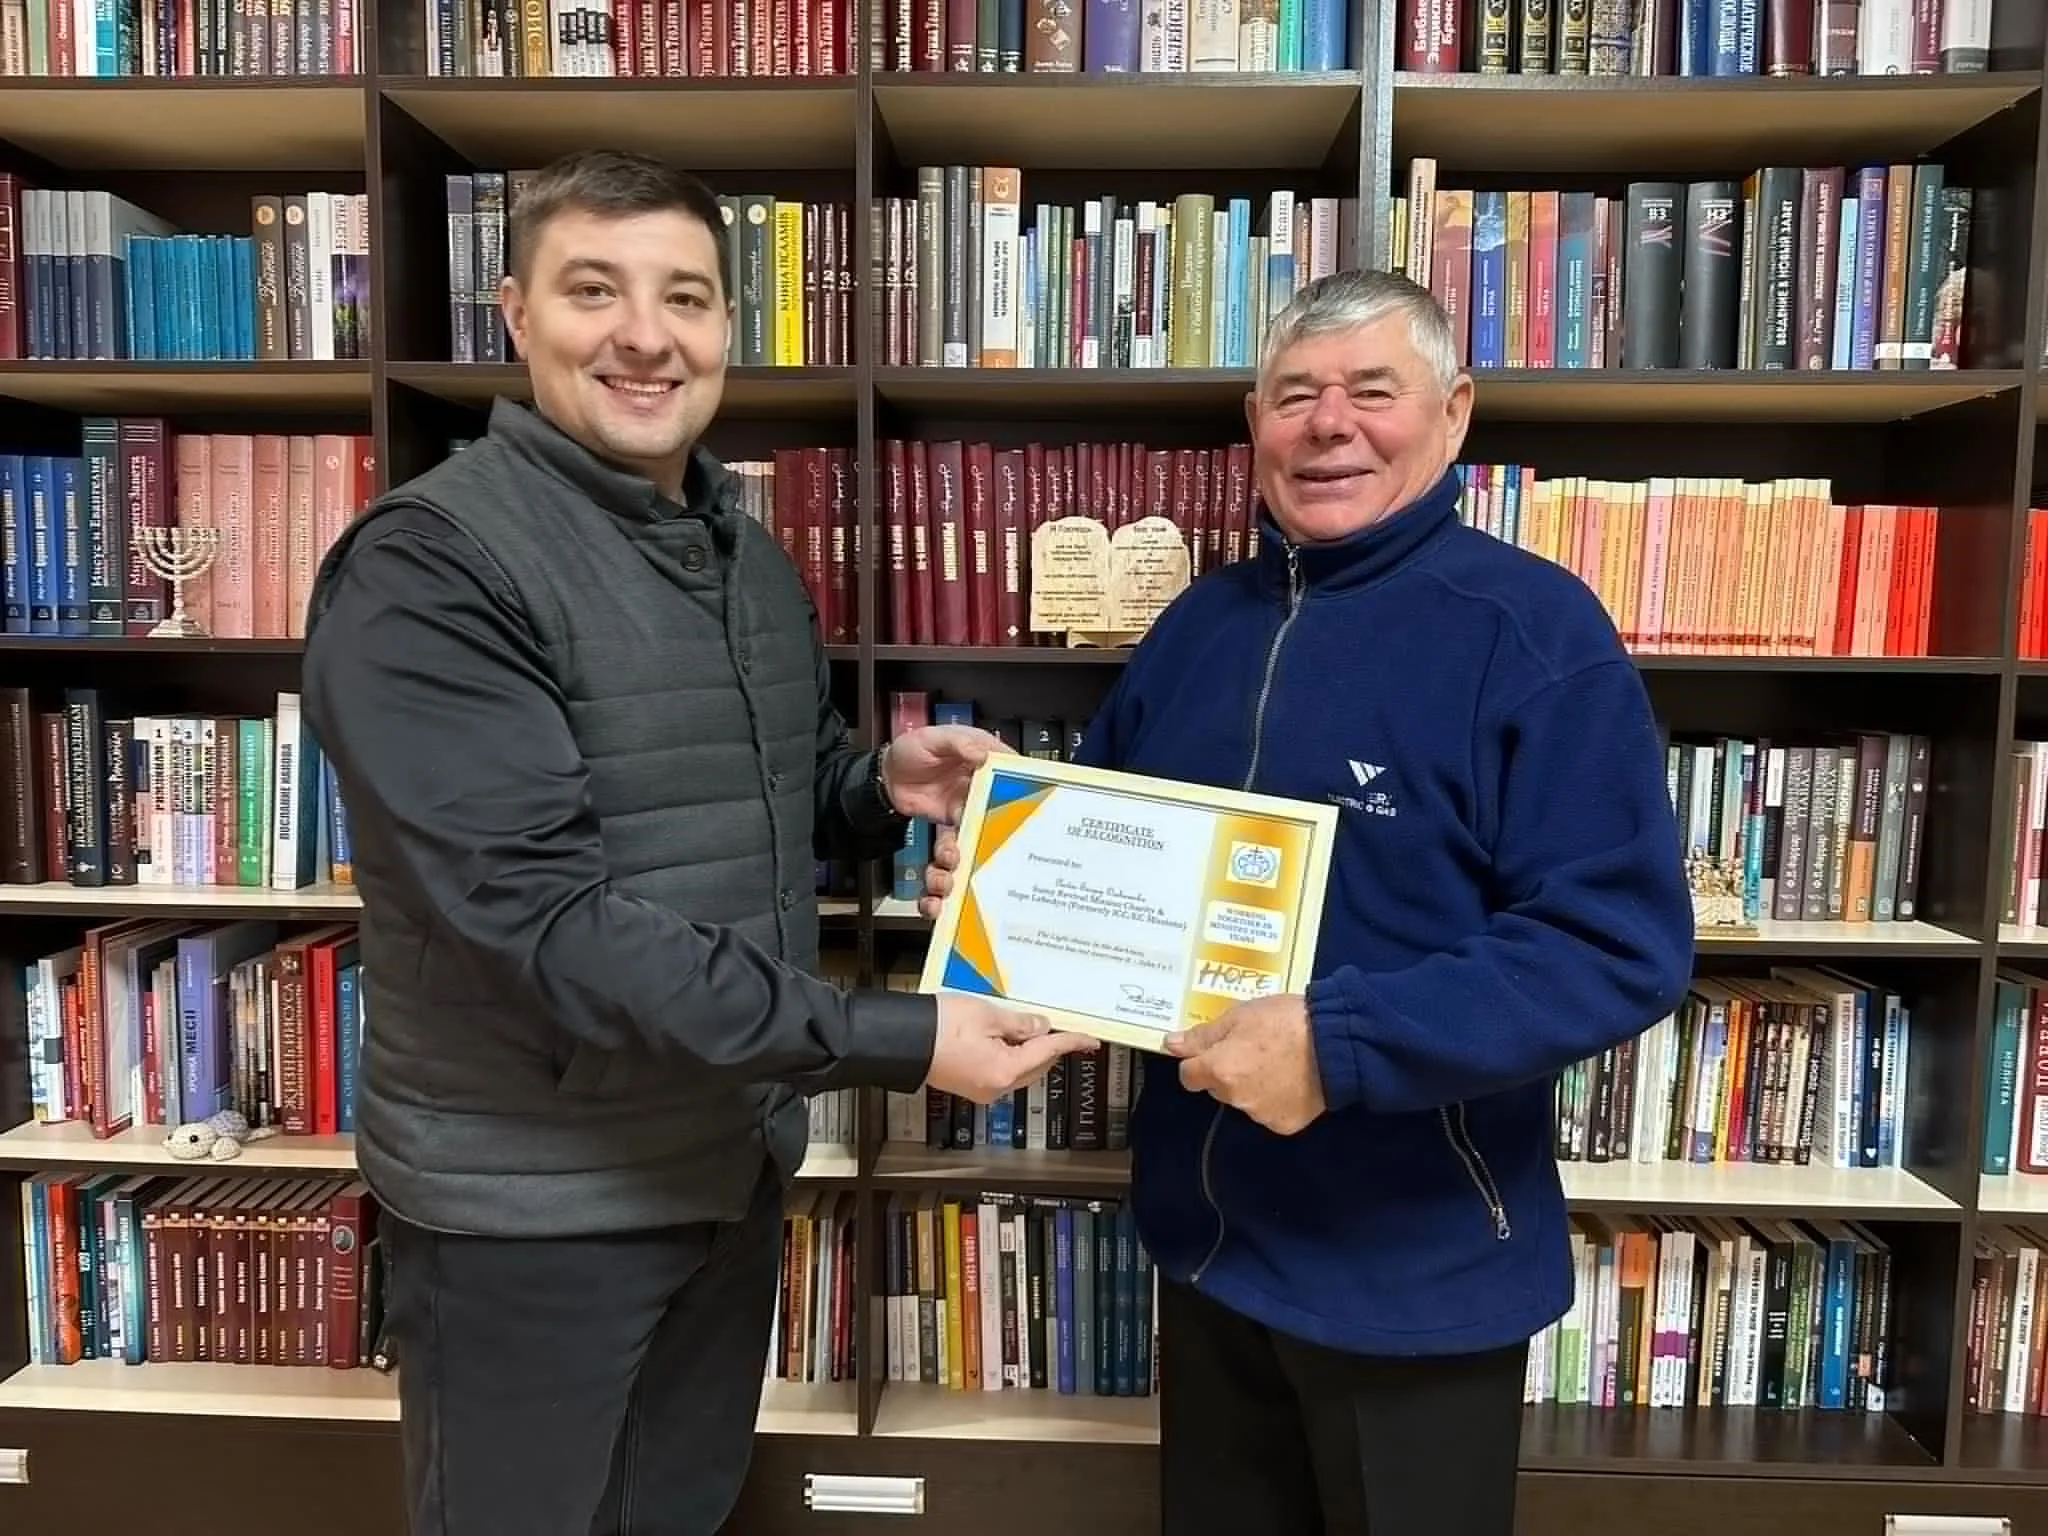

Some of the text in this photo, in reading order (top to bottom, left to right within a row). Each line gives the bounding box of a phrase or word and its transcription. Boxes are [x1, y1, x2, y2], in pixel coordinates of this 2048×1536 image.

[1781, 200, 1793, 234] ЗАВЕТ
[1778, 236, 1791, 278] НОВЫЙ
[155, 729, 163, 738] 1
[1040, 730, 1049, 742] 2
[1082, 817, 1155, 838] CERTIFICATE
[1085, 828, 1164, 850] RECOGNITION
[1198, 961, 1274, 990] HOPE
[282, 983, 297, 1044] ИИСУСА
[283, 1047, 298, 1110] ЖИЗНЬ
[1079, 1060, 1097, 1124] ПЛАМЯ
